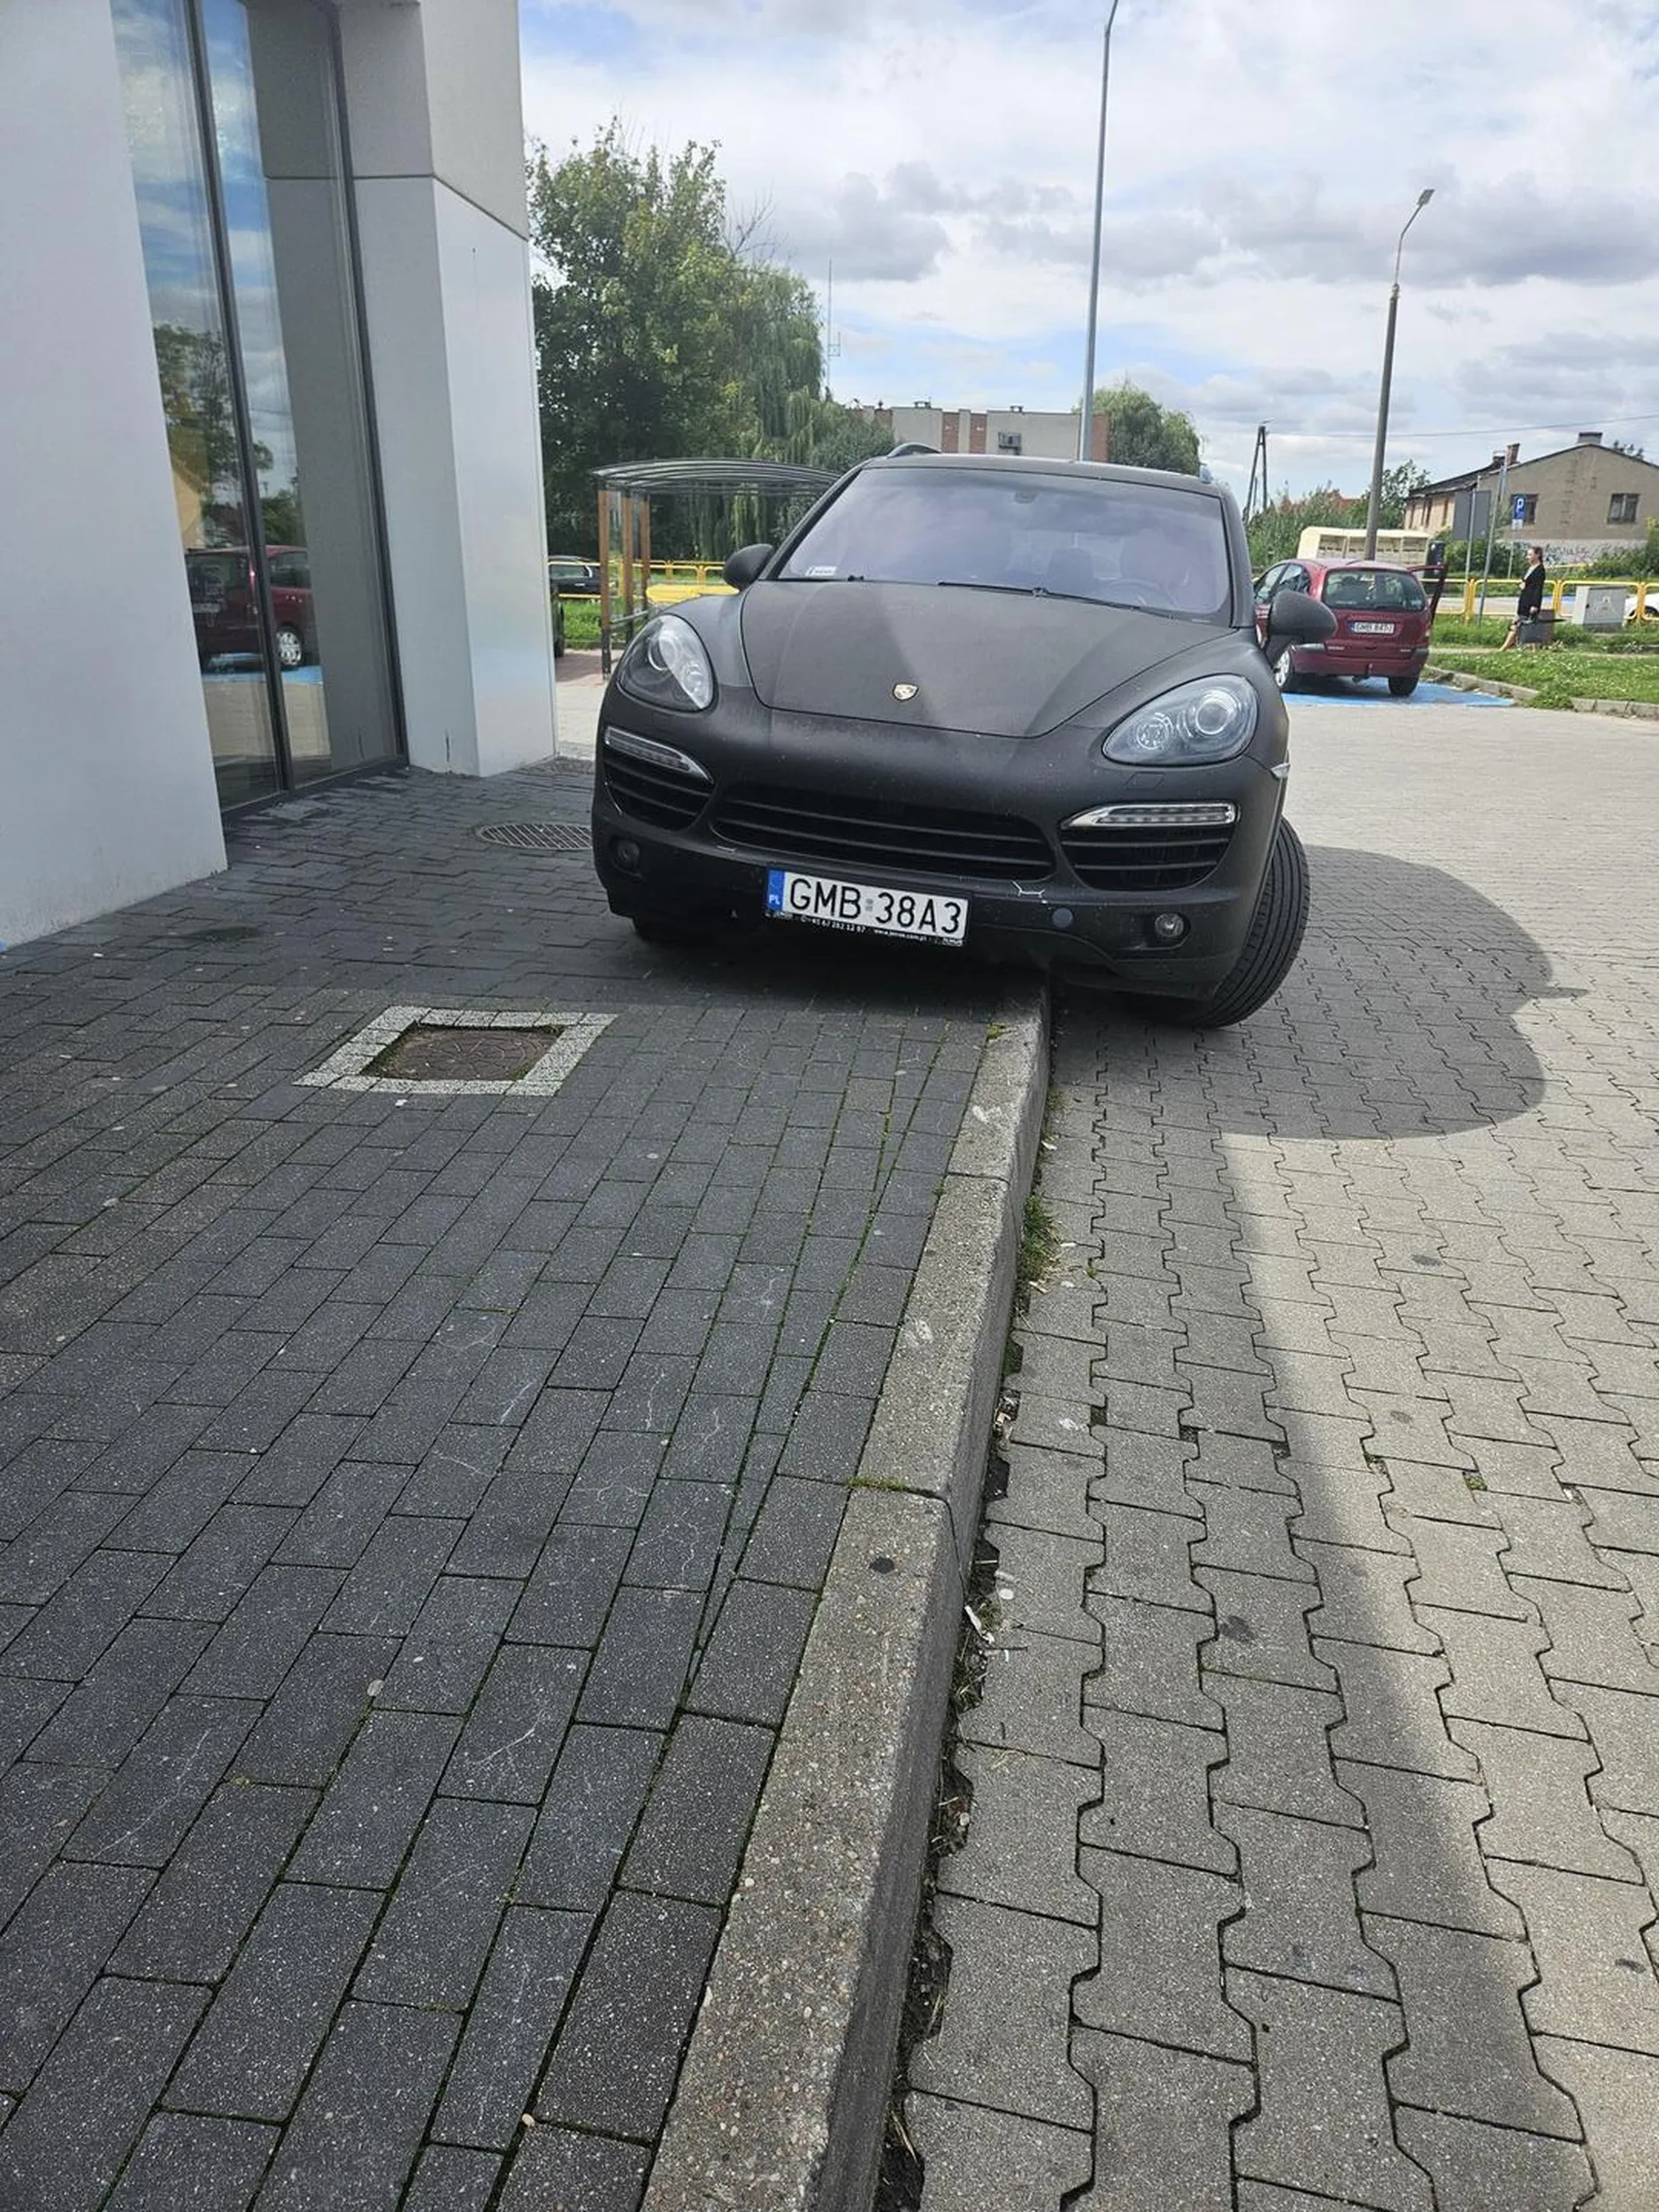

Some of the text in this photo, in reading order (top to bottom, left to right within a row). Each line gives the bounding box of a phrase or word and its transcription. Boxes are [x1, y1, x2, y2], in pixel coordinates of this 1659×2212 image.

[1516, 498, 1525, 512] P
[769, 895, 780, 905] PL
[789, 878, 962, 933] GMB 38A3
